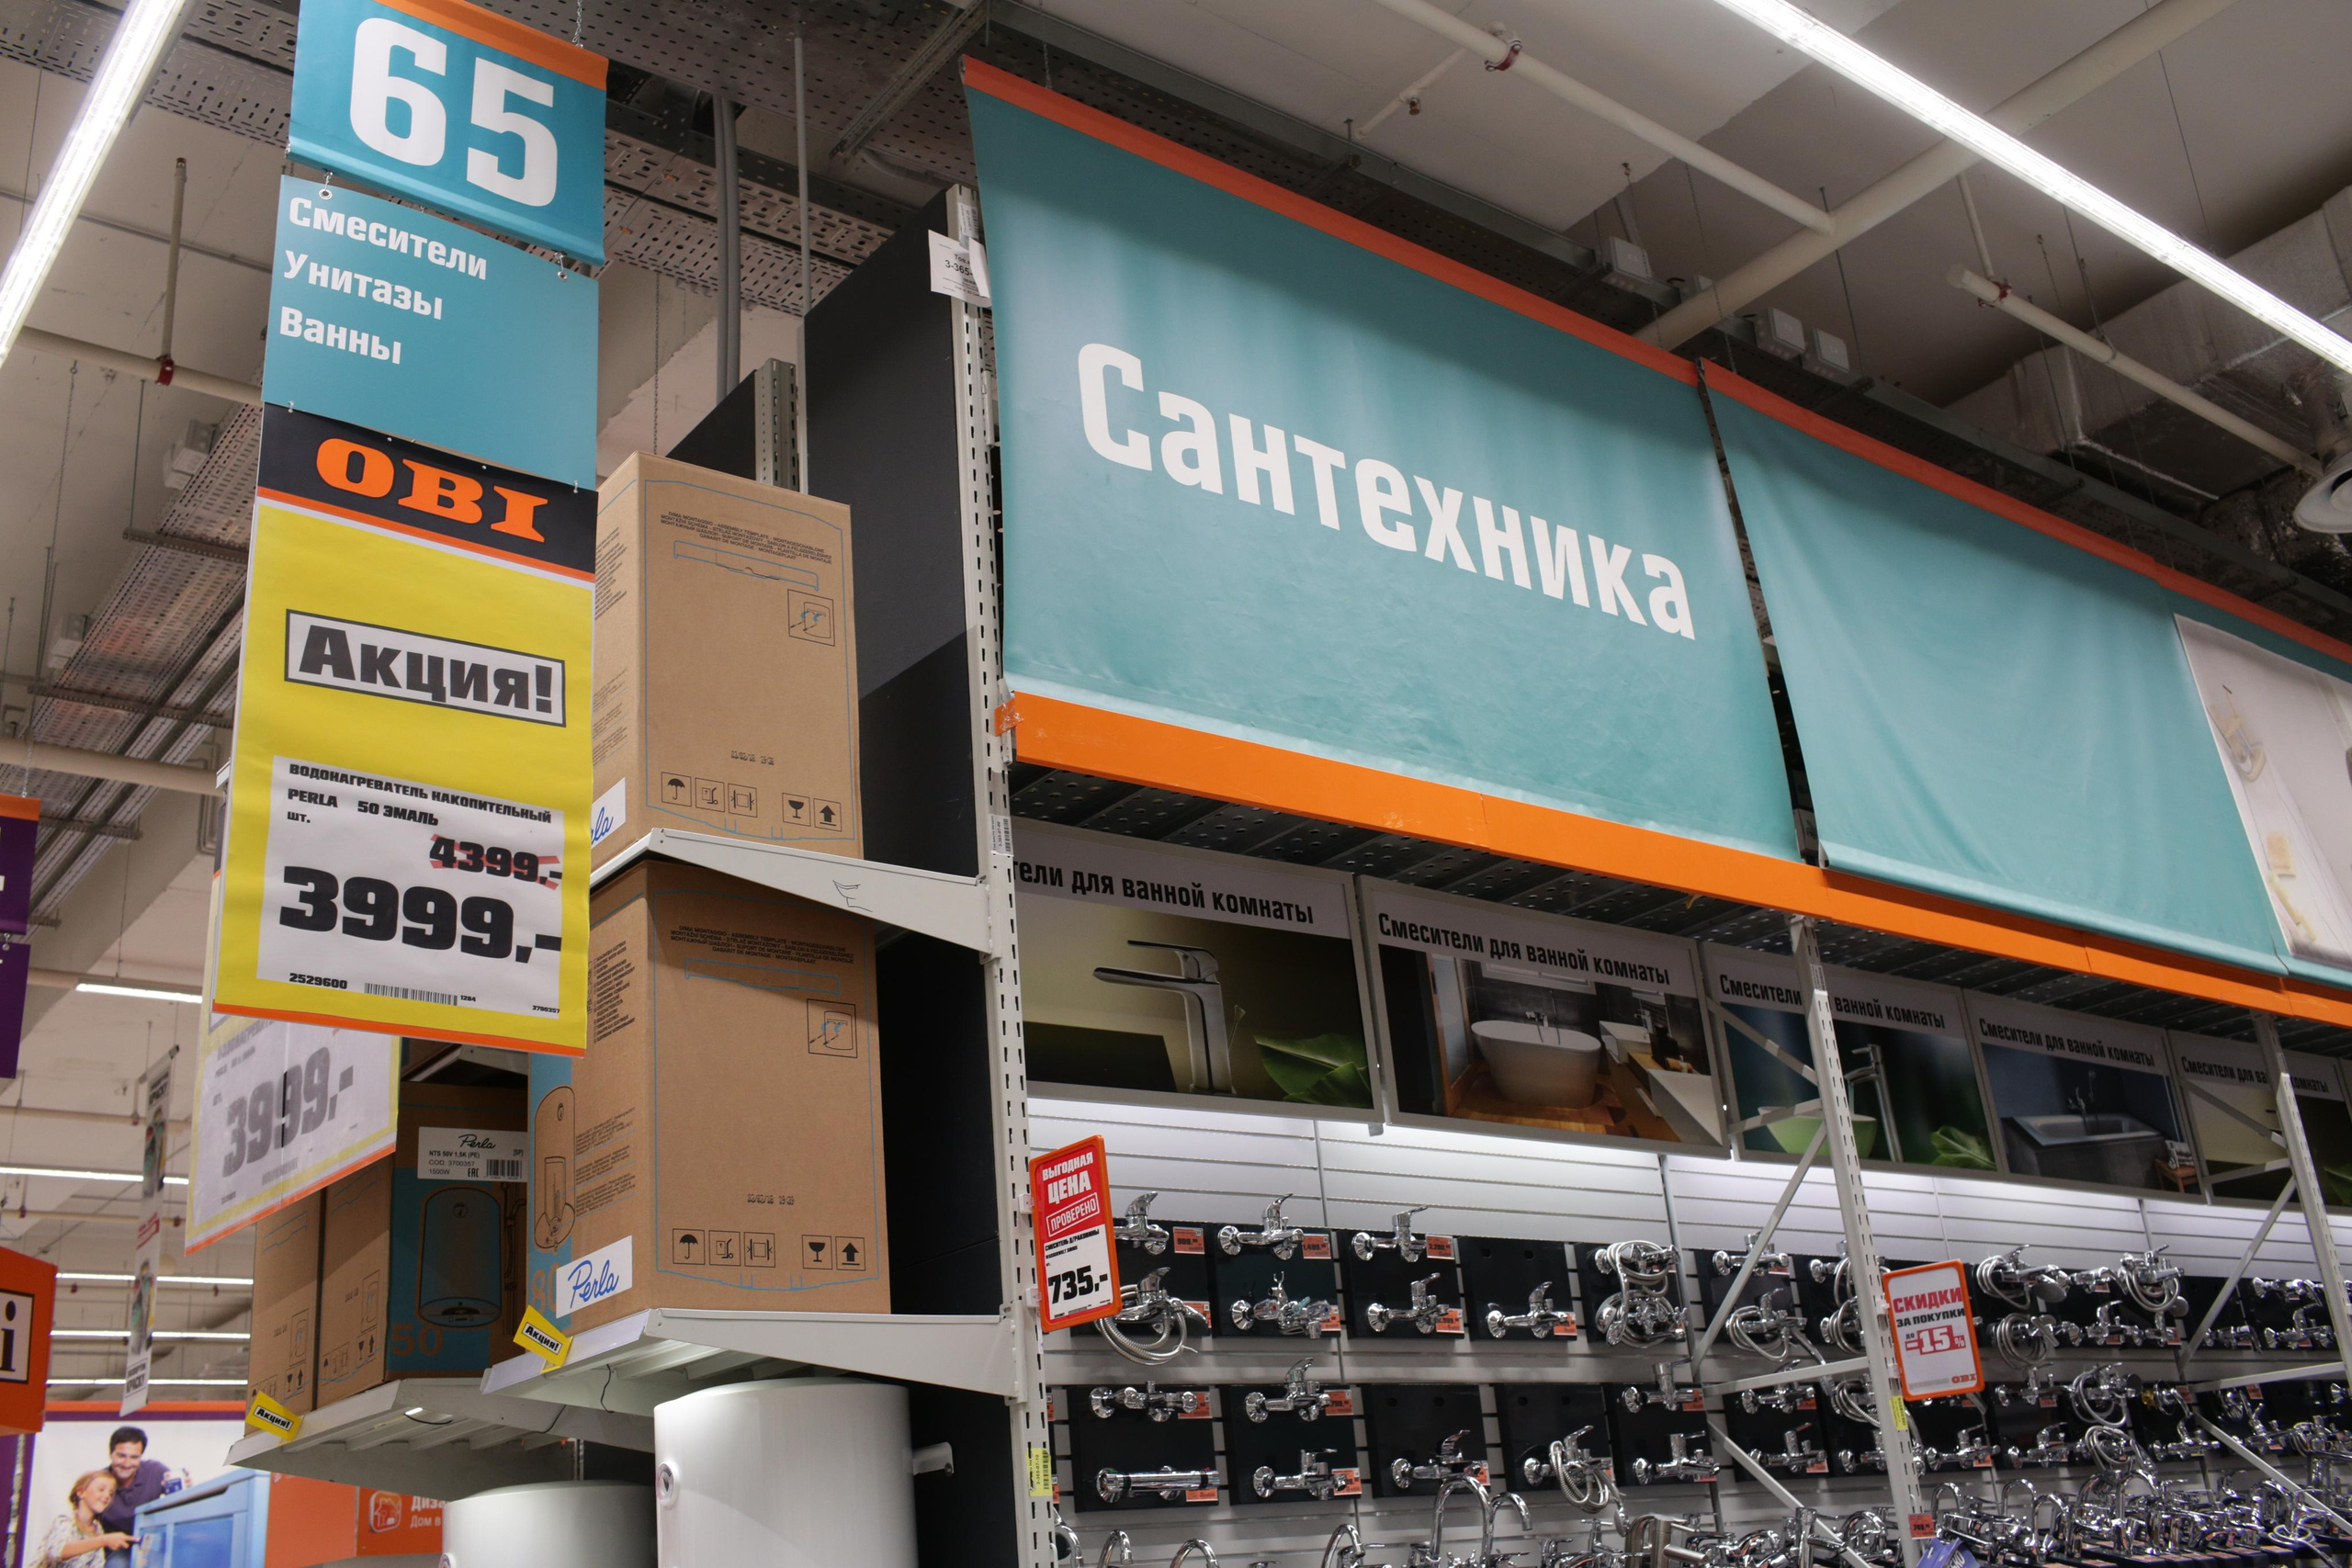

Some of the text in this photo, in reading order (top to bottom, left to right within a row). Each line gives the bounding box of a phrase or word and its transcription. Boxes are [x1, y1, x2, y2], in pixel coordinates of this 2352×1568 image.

[350, 17, 558, 207] 65
[288, 197, 487, 280] Смесители
[284, 251, 443, 320] Унитазы
[279, 307, 401, 365] Ванны
[316, 437, 548, 543] OBI
[1078, 343, 1695, 640] Сантехника
[299, 625, 552, 714] Акция!
[288, 788, 439, 826] PERLA 50 ЭМАЛЬ
[289, 763, 551, 824] ВОДОНАГРЕВАТЕЛЬ НАКОПИТЕЛЬНЫЙ
[279, 865, 561, 964] 3999,-
[1071, 871, 1114, 895] для
[1122, 878, 1205, 908] ванной
[1213, 892, 1314, 924] комнаты
[1379, 912, 1669, 985] Смесители для ванной комнаты
[288, 973, 347, 990] 2529600
[1720, 975, 1945, 1029] Смесители ванной комнаты
[1980, 1019, 2154, 1066] Смесители для ванной комнаты
[2181, 1057, 2235, 1079] Смесители
[2237, 1068, 2255, 1083] для
[458, 1134, 496, 1149] Perla
[1042, 1152, 1093, 1181] ВЫГОДНАЯ
[1047, 1170, 1091, 1204] ЦЕНА
[1050, 1198, 1097, 1232] ПРОВЕРЕНО
[567, 1260, 619, 1309] Perla
[1047, 1265, 1108, 1304] 735,-
[1893, 1287, 1963, 1314] СКИДКИ
[1896, 1308, 1966, 1327] ЗА ПОКУПКИ
[391, 1323, 444, 1357] 50
[525, 1325, 560, 1351] Акция!
[1951, 1373, 1977, 1383] OBI
[255, 1408, 291, 1429] Акция!
[410, 1515, 441, 1529] Дом в
